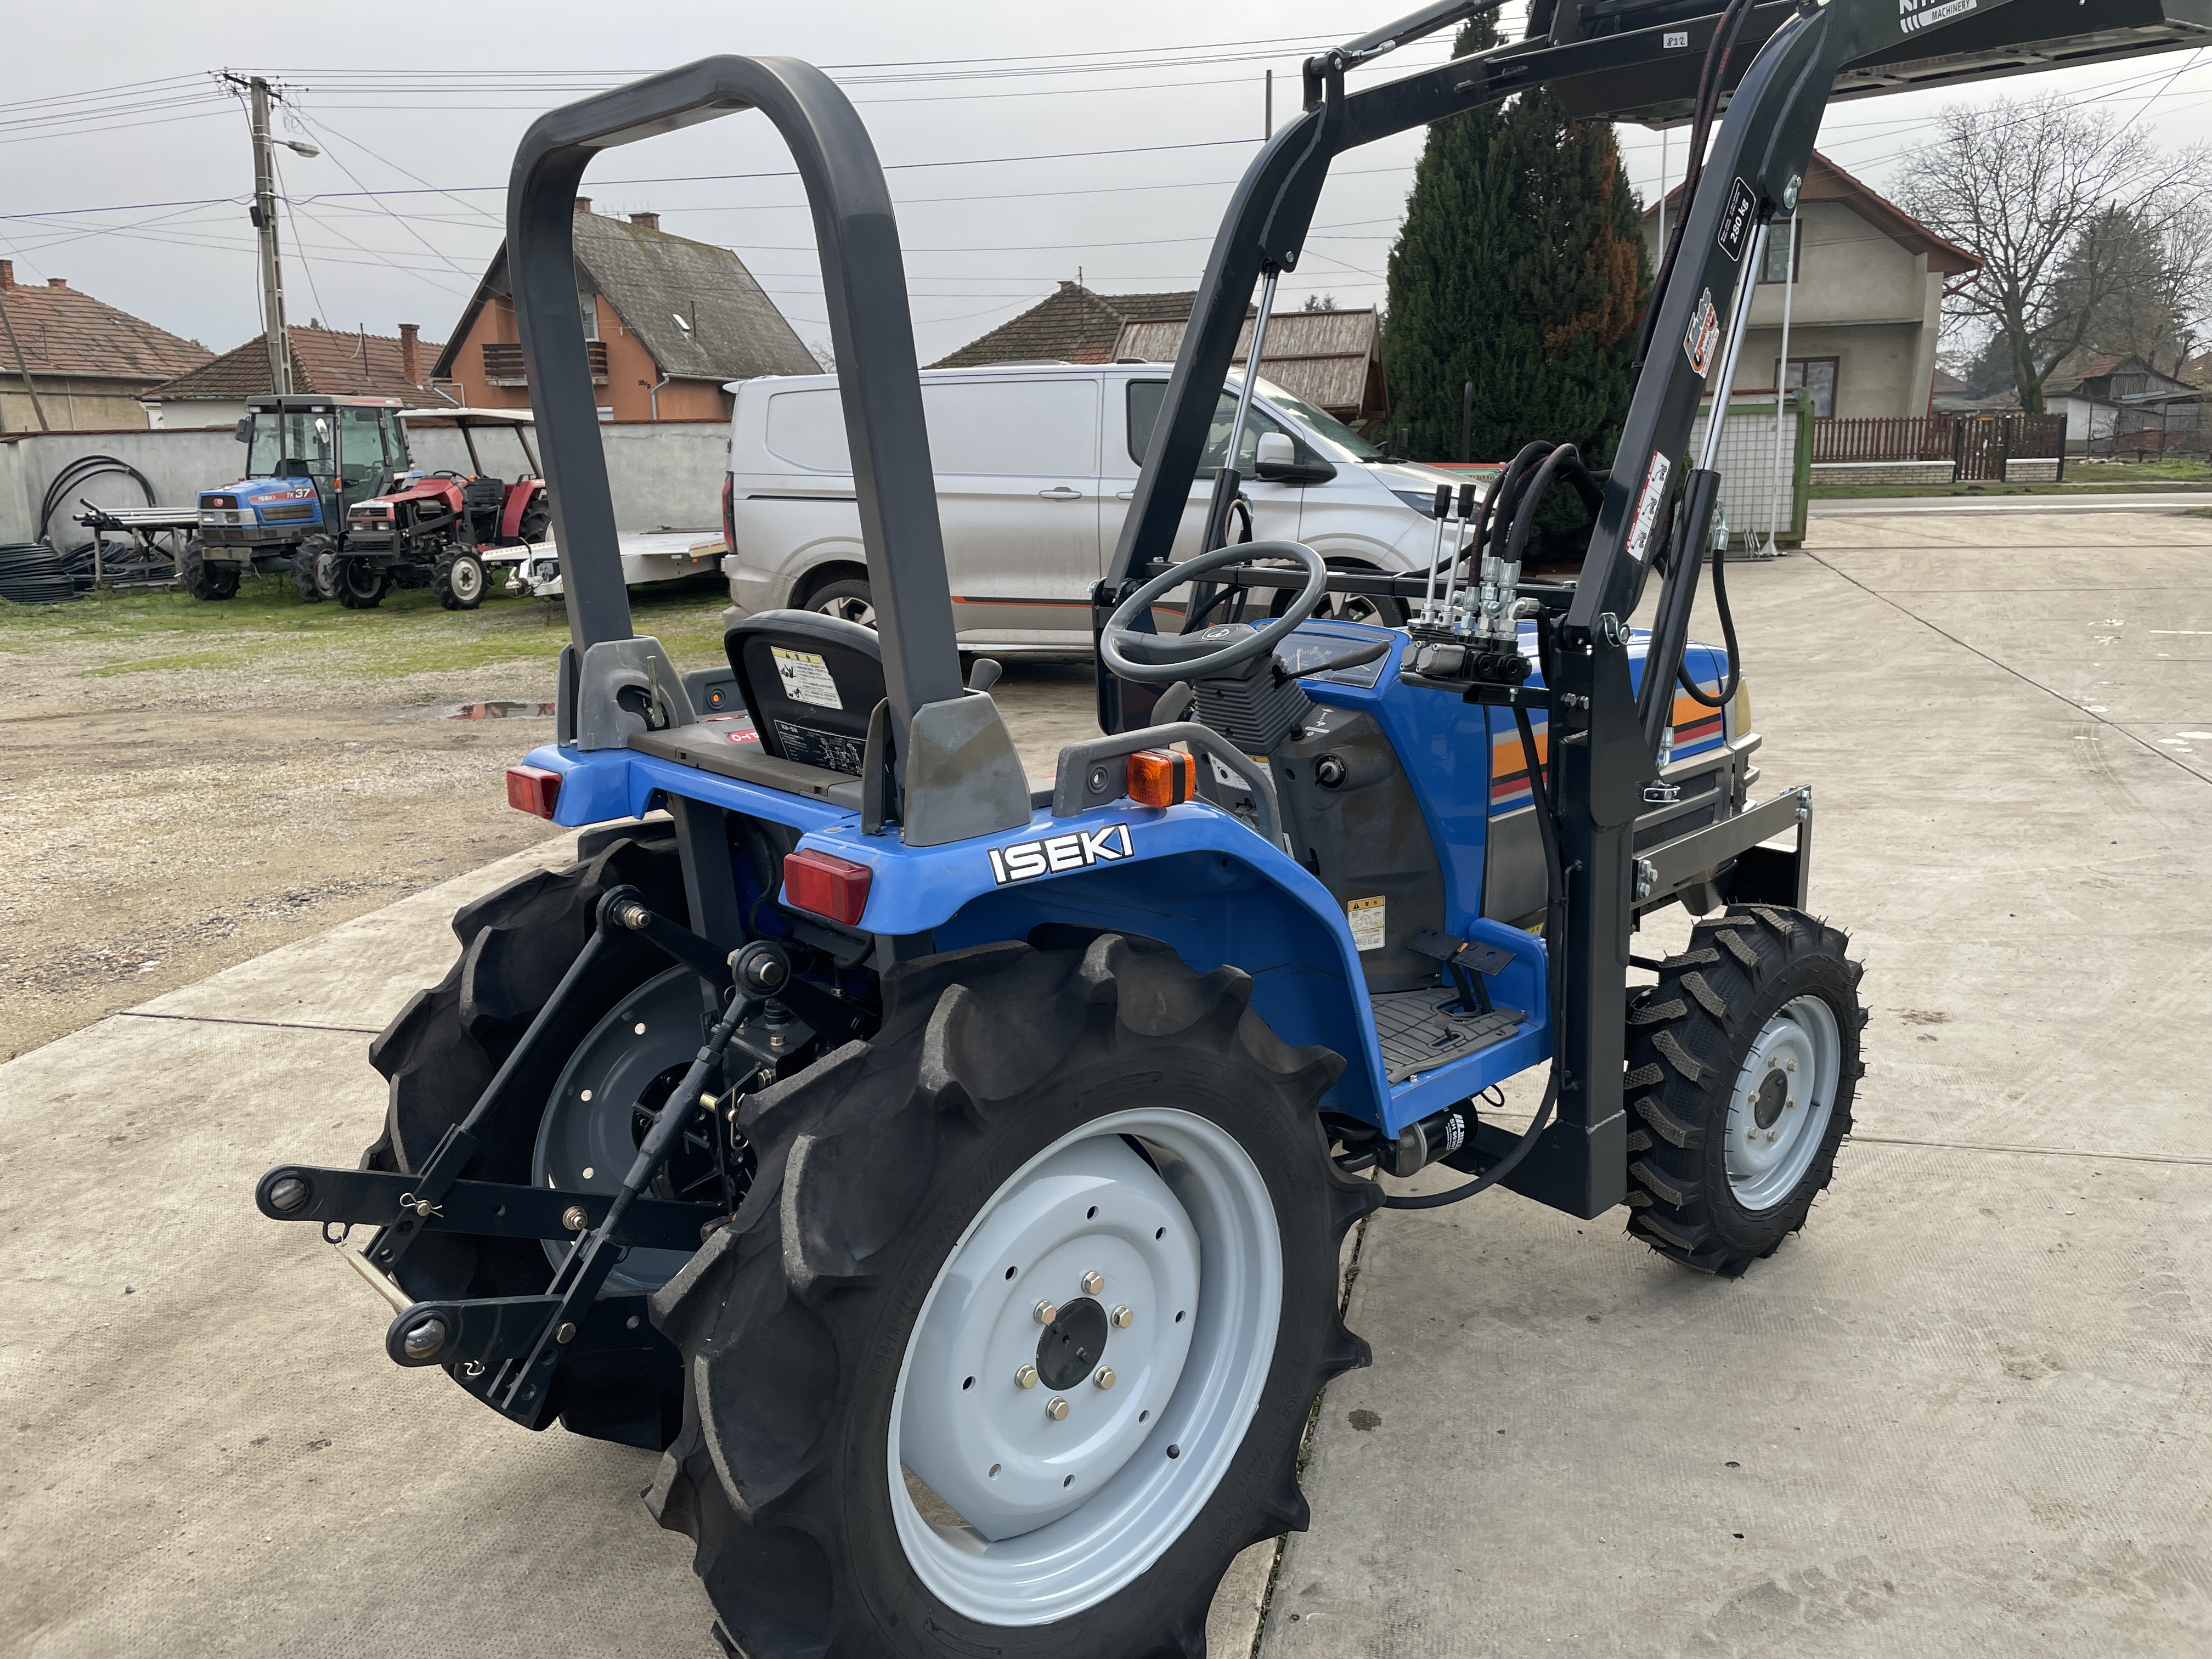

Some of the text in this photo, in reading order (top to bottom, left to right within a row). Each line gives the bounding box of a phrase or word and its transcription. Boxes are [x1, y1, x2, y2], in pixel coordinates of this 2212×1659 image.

[1932, 0, 1970, 21] MACHINERY
[1667, 37, 1685, 46] 832
[1730, 216, 1742, 244] 280
[1737, 198, 1749, 216] kg
[295, 488, 311, 498] 37
[731, 732, 759, 741] PTO
[988, 823, 1134, 884] ISEKI
[1449, 1118, 1457, 1130] SH
